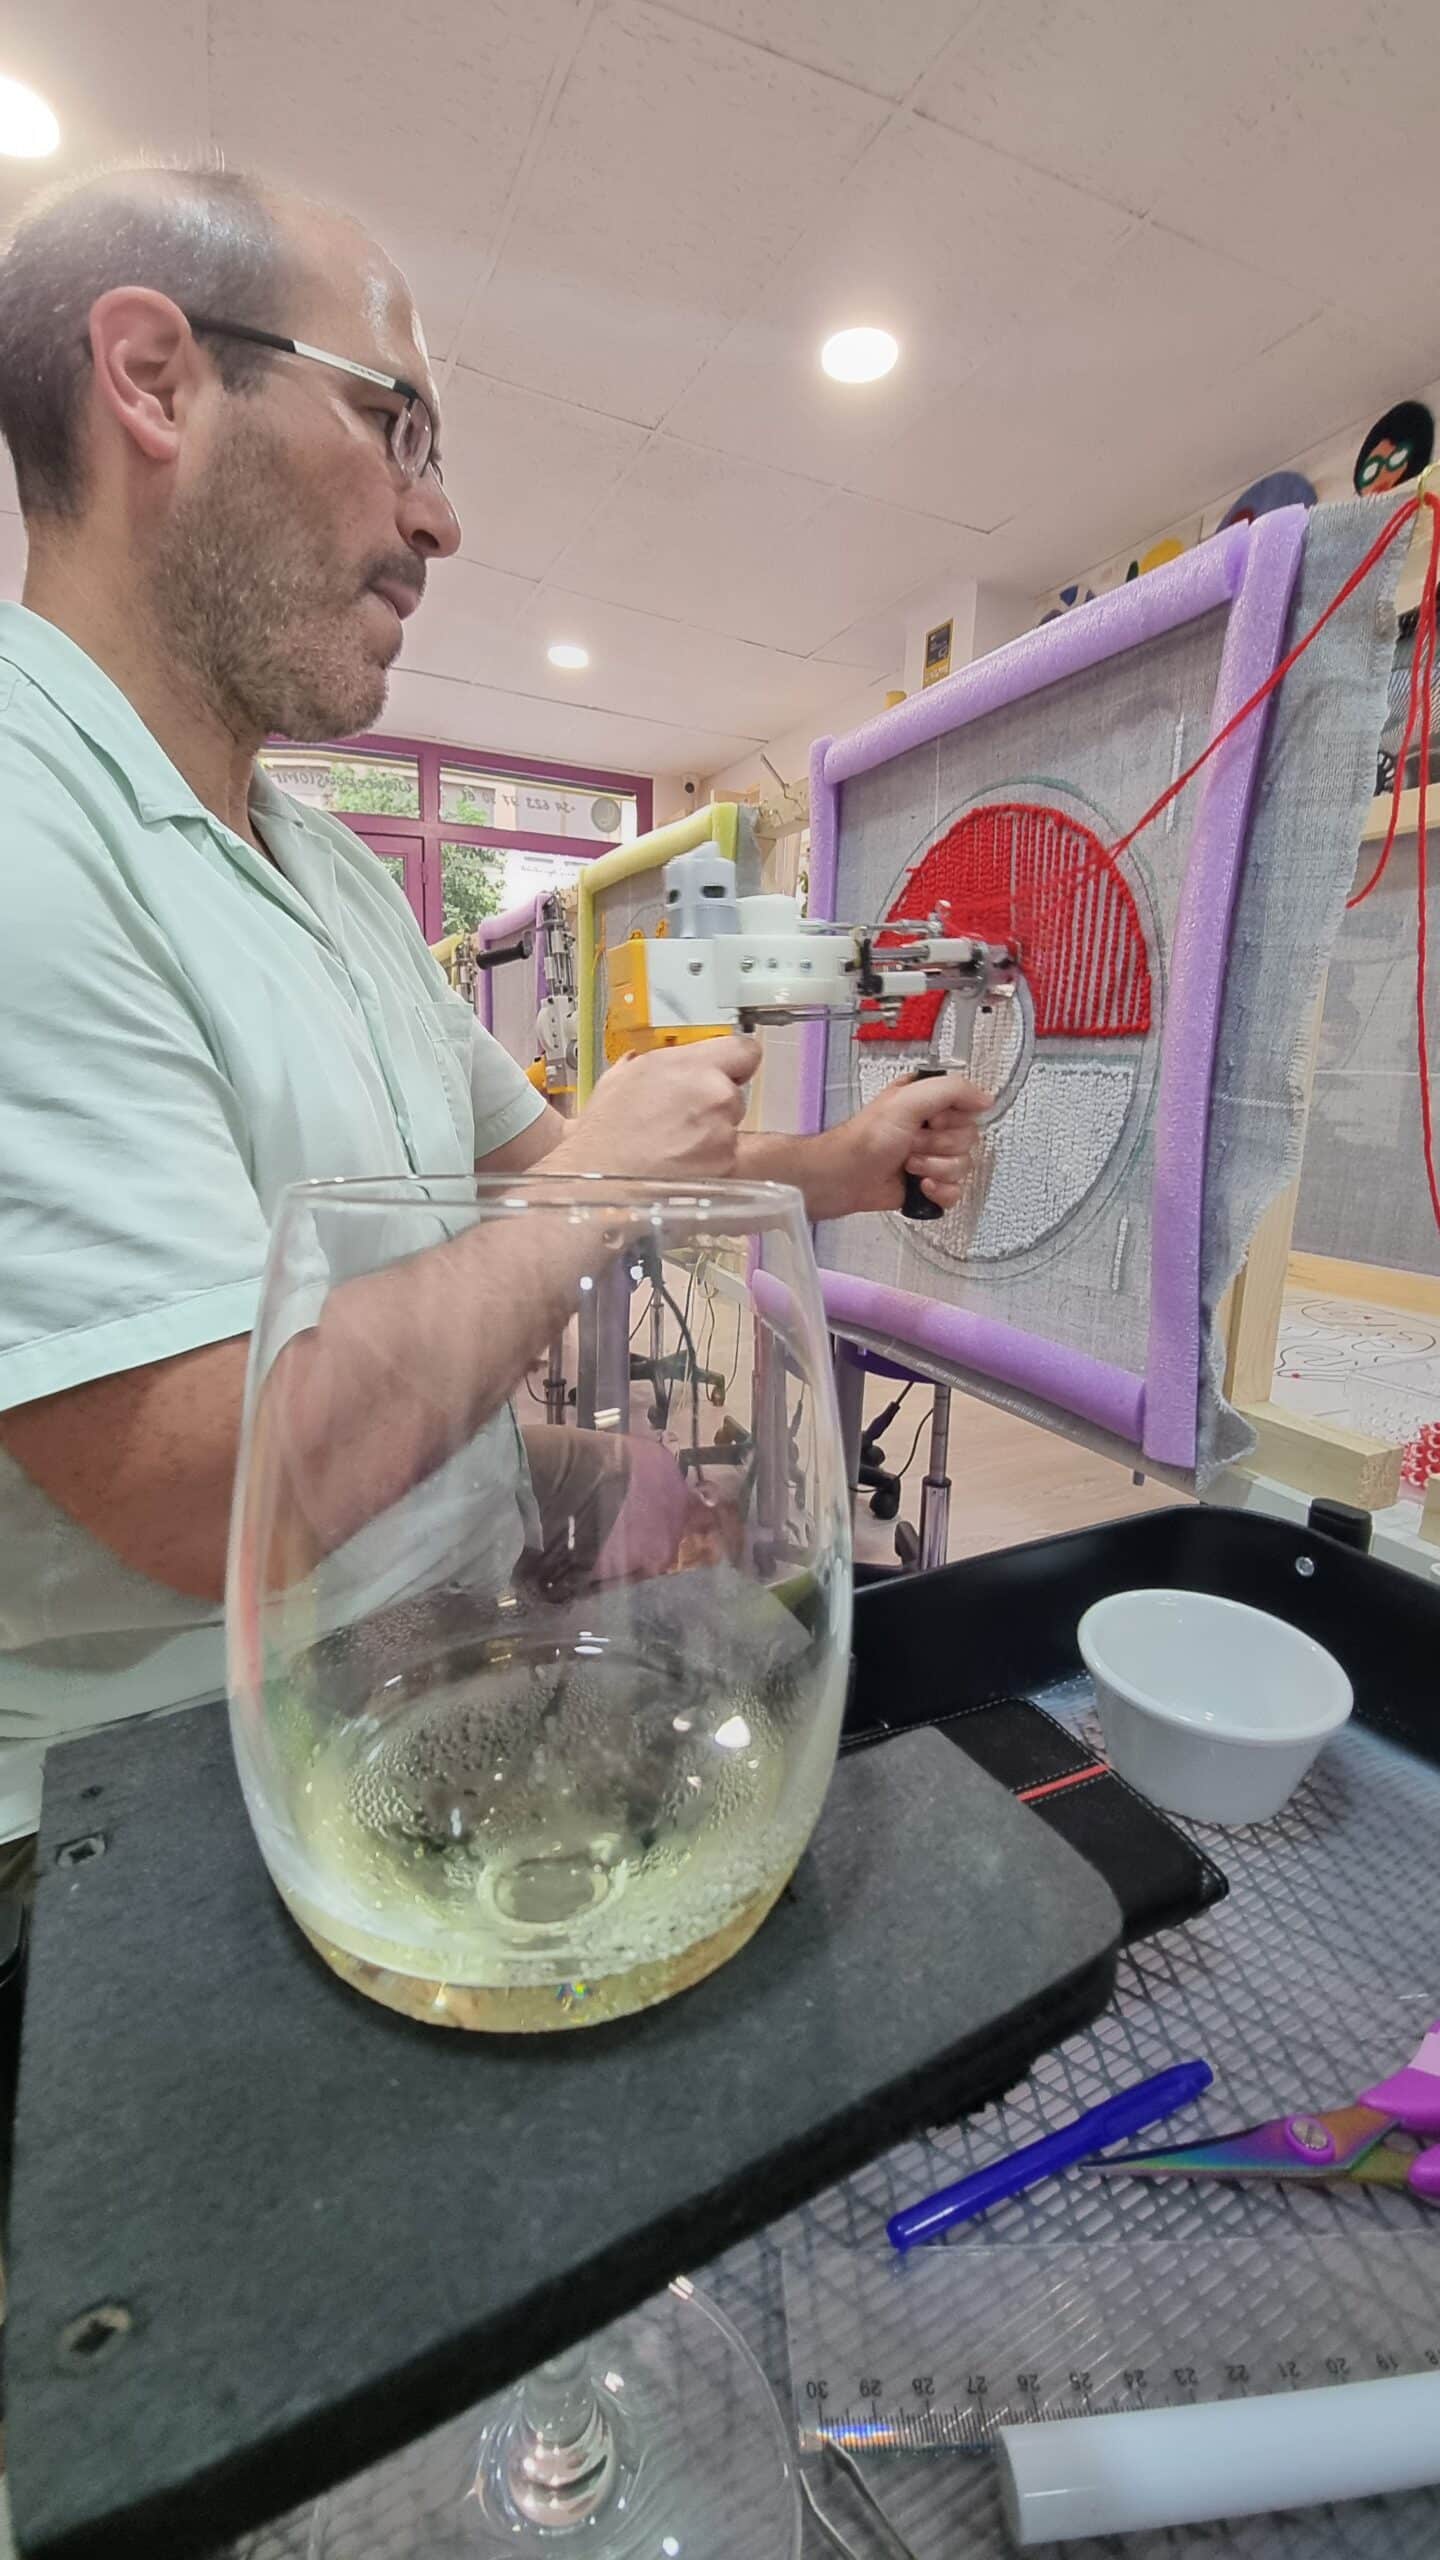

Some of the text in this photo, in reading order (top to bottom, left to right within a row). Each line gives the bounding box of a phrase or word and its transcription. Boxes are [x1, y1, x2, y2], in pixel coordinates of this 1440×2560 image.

[1225, 2364, 1249, 2383] 22
[1278, 2361, 1300, 2378] 21
[1325, 2358, 1349, 2375] 20
[911, 2376, 934, 2395] 28
[967, 2375, 988, 2394] 27
[1017, 2373, 1040, 2393] 26
[1069, 2371, 1092, 2392] 25
[1123, 2369, 1147, 2389] 24
[1173, 2367, 1197, 2386] 23
[806, 2380, 828, 2399] 30
[859, 2379, 882, 2397] 29
